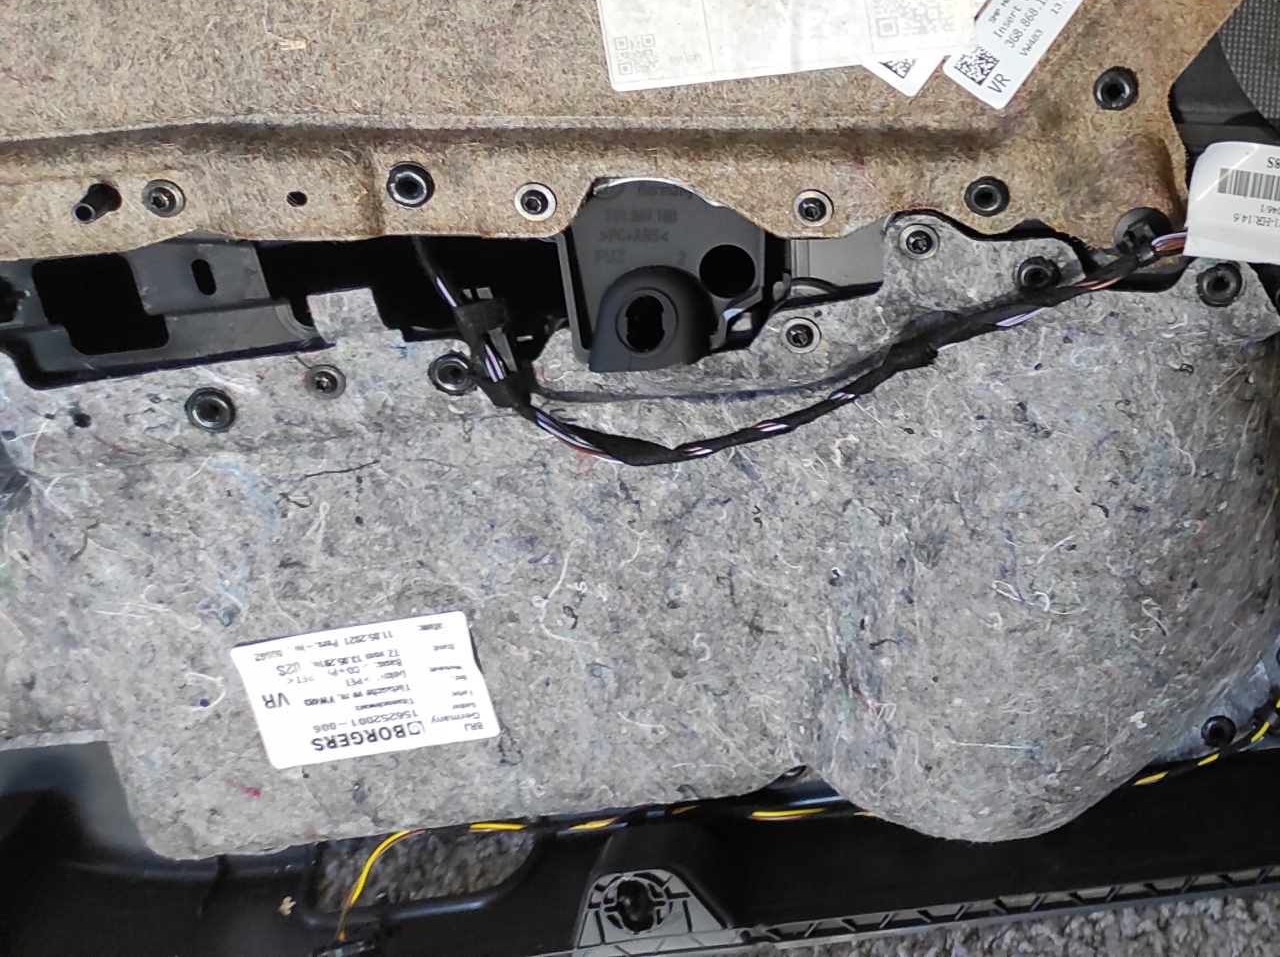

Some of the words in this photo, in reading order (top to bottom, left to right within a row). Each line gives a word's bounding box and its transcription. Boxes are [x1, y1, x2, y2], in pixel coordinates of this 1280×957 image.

[993, 7, 1022, 39] Insert
[987, 73, 1011, 93] VR
[261, 691, 291, 710] VR
[430, 711, 481, 725] Germany
[310, 724, 407, 752] BORGERS
